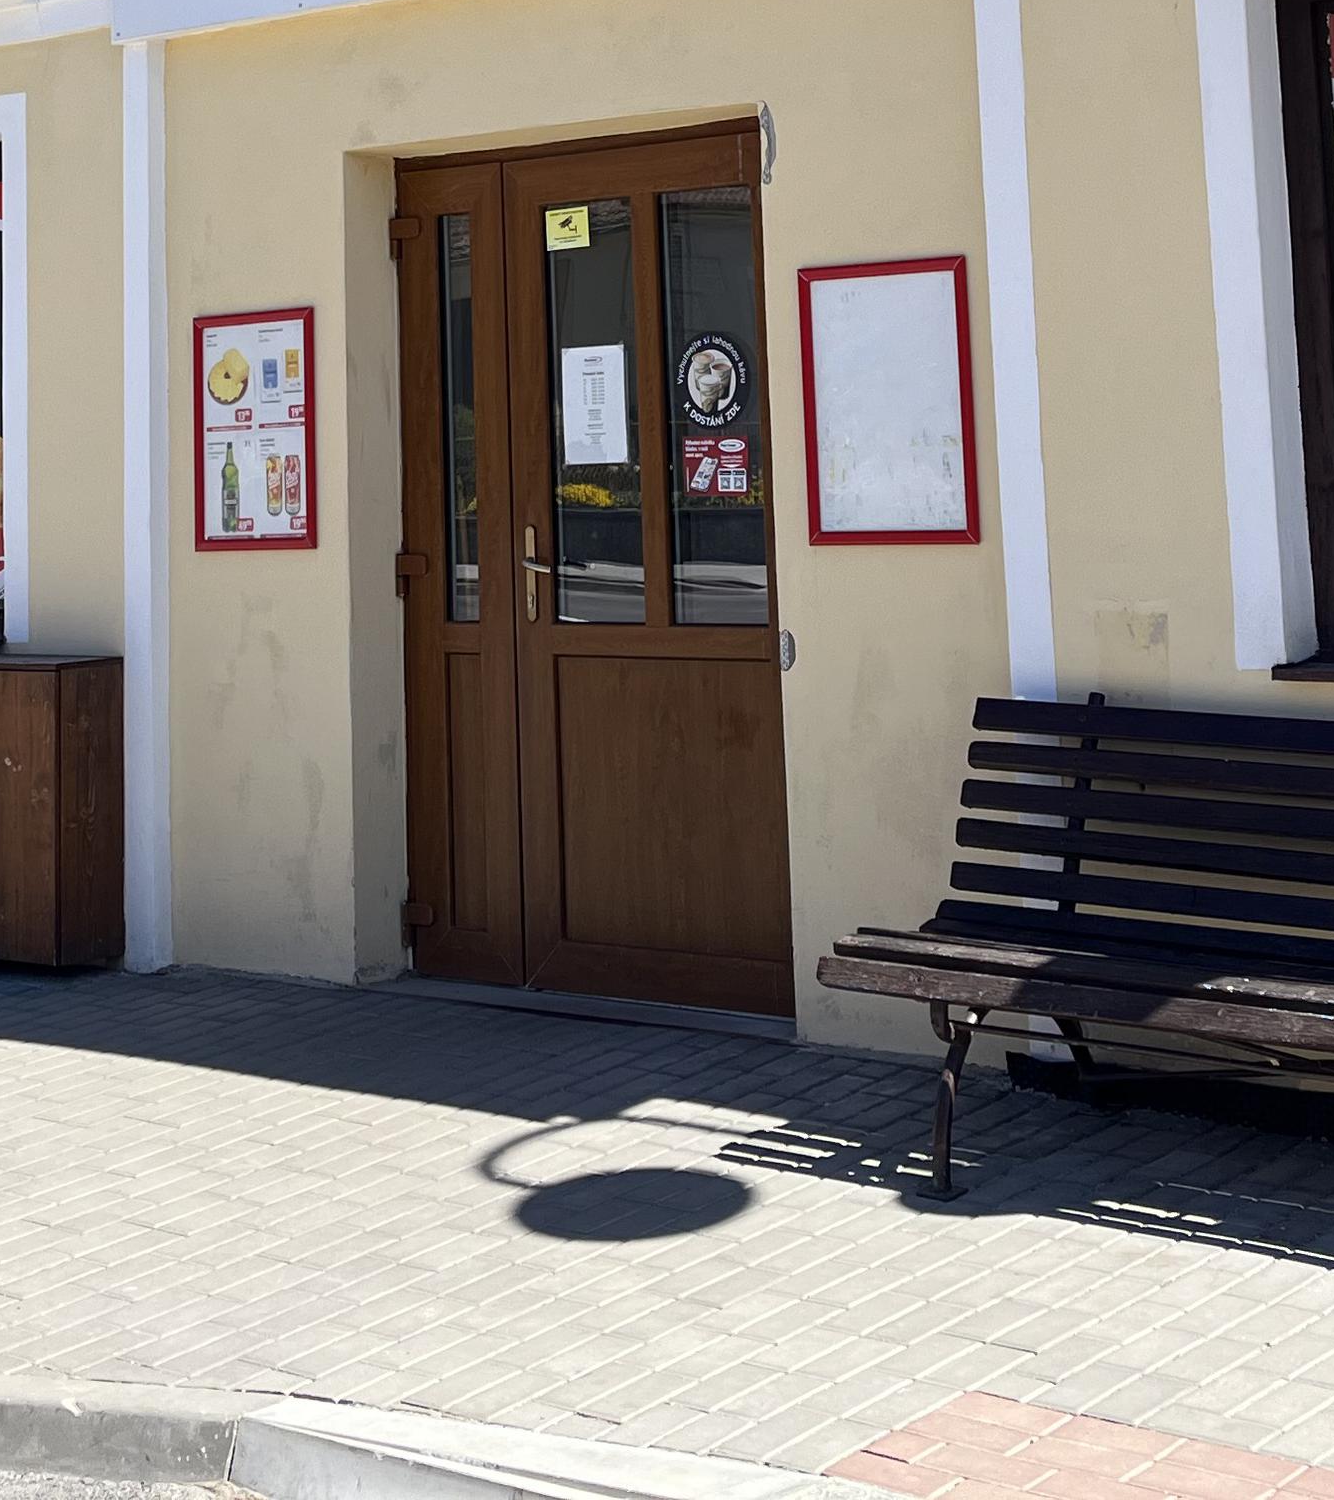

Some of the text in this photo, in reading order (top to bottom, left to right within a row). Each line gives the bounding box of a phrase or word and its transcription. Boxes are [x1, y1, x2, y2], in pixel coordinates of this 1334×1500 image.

[677, 339, 702, 385] Vychutnejte
[712, 335, 741, 362] lahodnou
[682, 401, 742, 428] K DOSTÁNÍ ZDE
